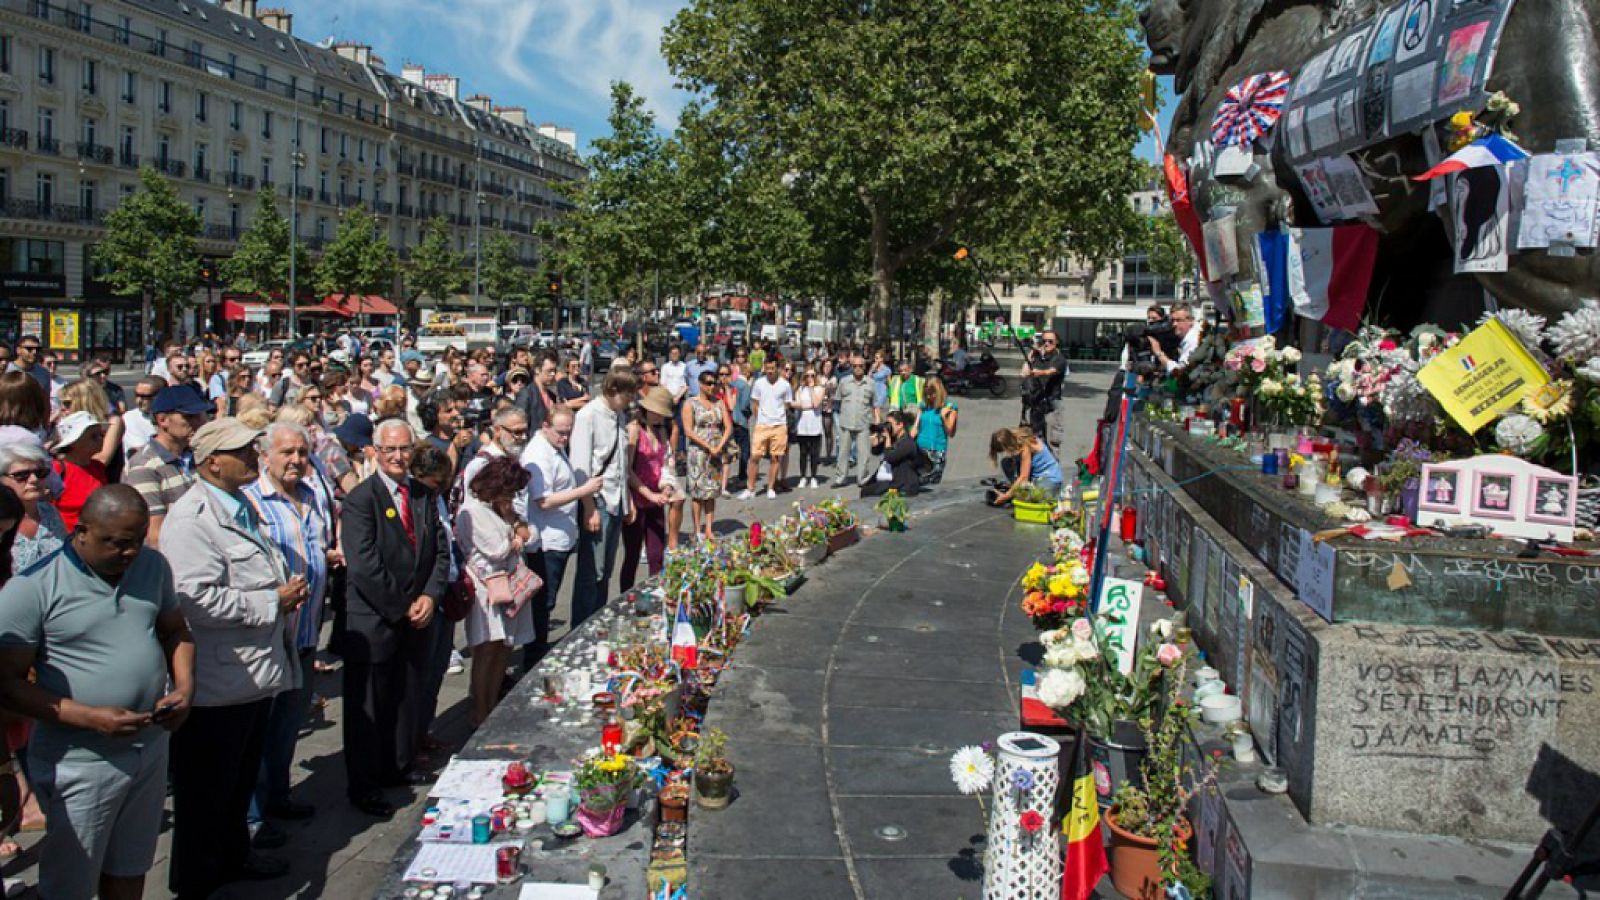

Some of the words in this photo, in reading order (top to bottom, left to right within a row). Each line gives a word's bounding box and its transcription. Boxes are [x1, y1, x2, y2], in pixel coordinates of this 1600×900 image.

[1357, 662, 1417, 684] VOS
[1432, 663, 1593, 694] FLAMMES
[1351, 723, 1497, 751] JAMAIS
